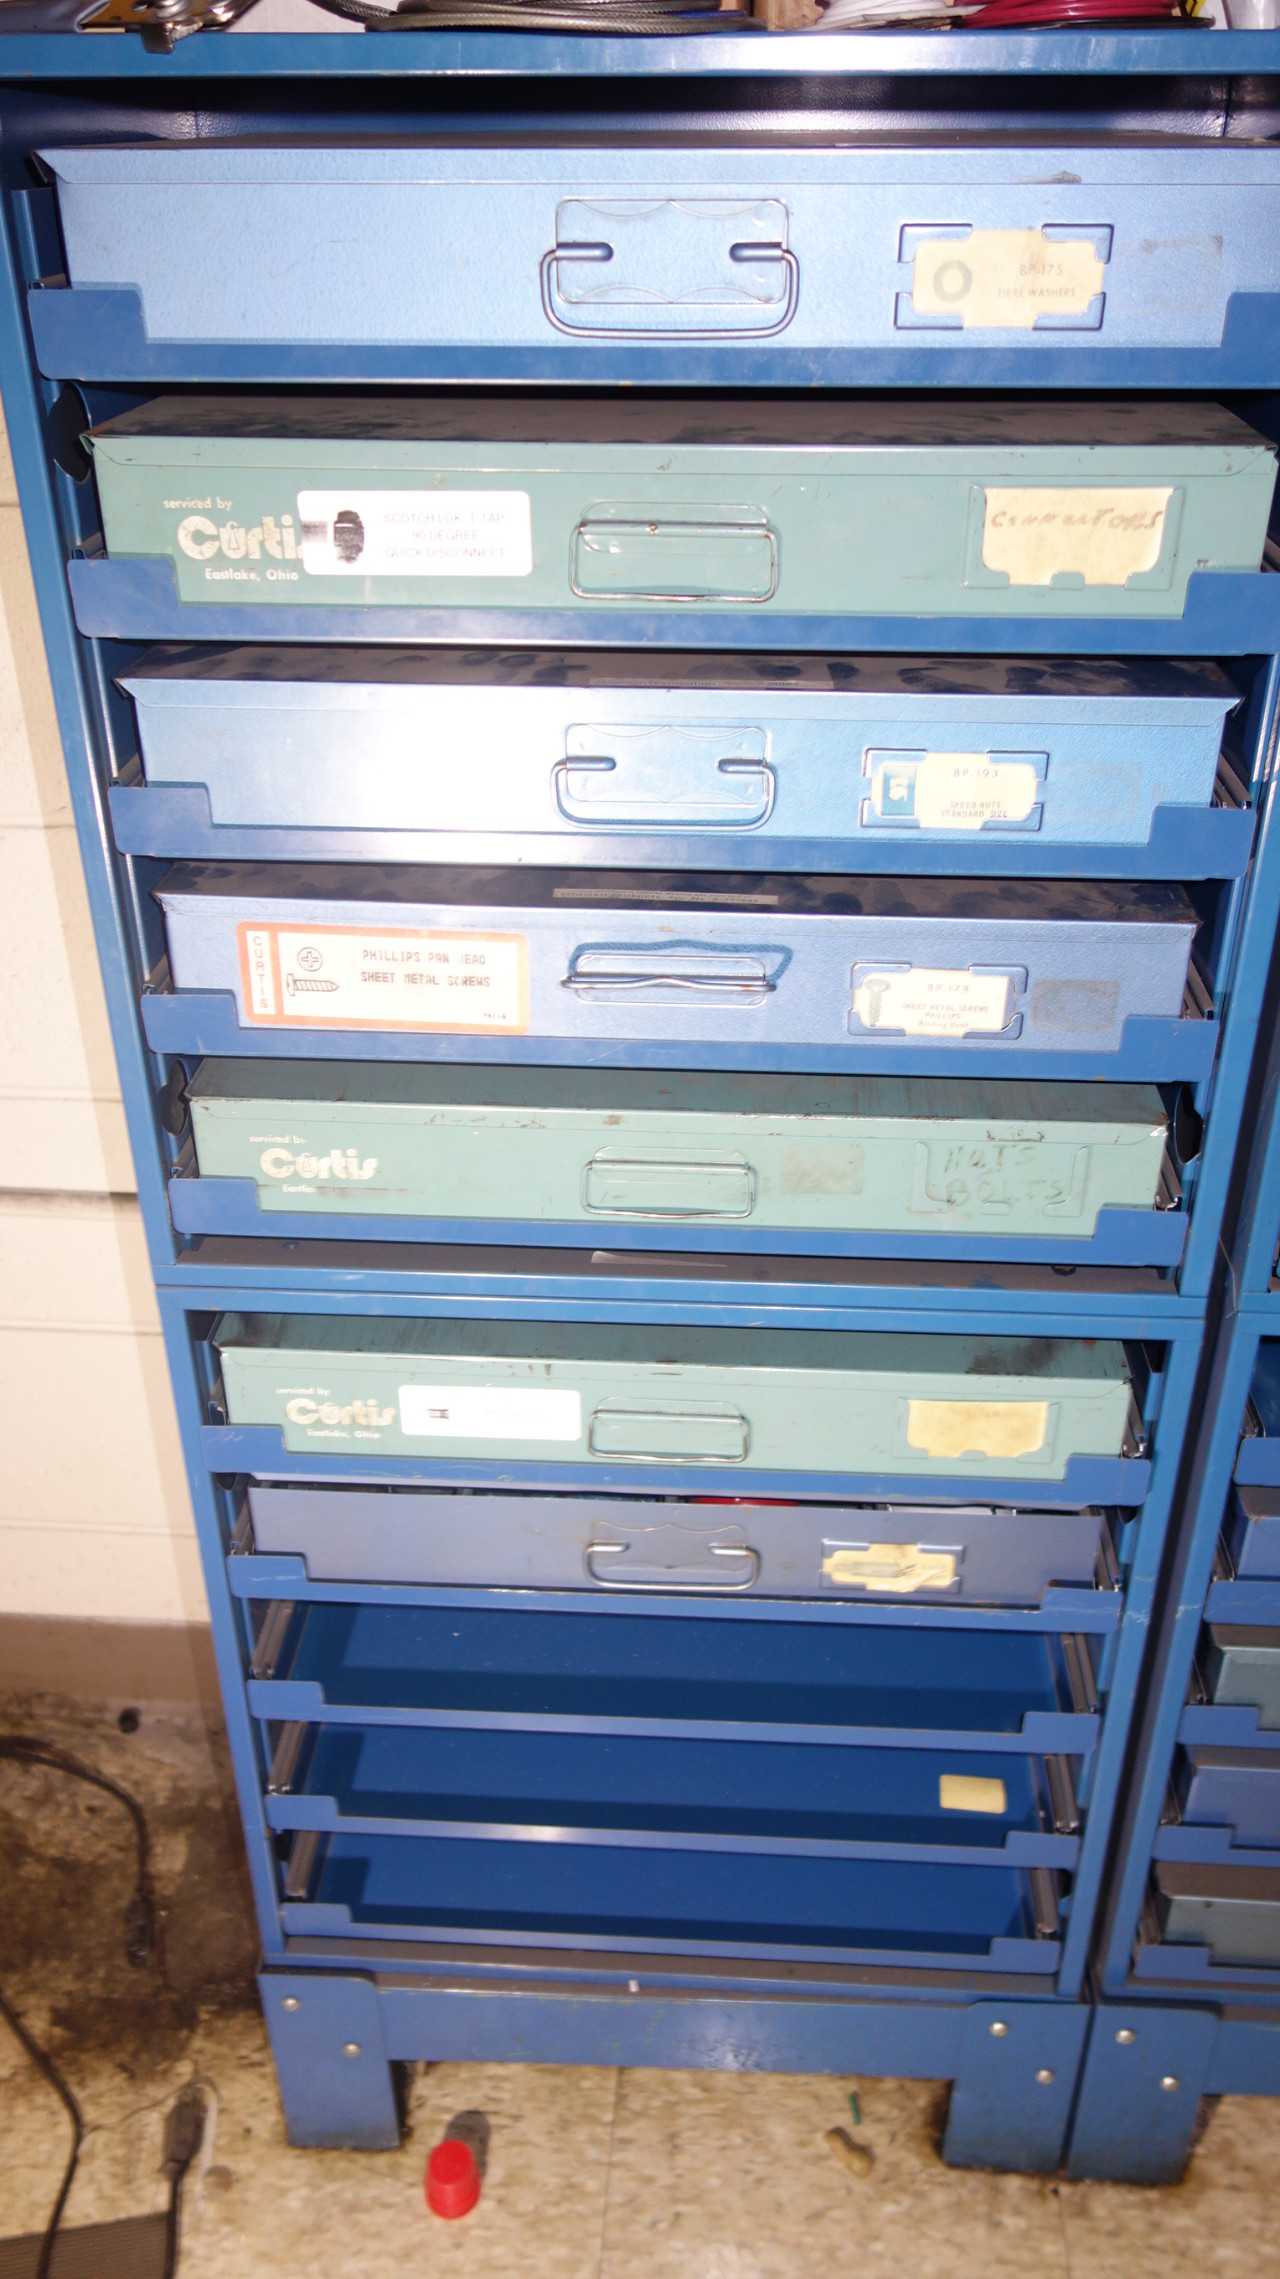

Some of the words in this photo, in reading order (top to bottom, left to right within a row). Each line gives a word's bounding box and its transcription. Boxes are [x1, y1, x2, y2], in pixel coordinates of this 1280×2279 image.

[162, 496, 212, 510] serviced
[215, 495, 233, 512] by
[177, 515, 303, 560] Curti
[204, 567, 261, 582] Eastlake,
[265, 568, 299, 582] Ohio
[361, 949, 421, 963] PHILLIPS
[427, 952, 450, 964] PAN
[457, 954, 487, 966] EAD
[360, 971, 396, 983] SHEET
[403, 973, 440, 986] METAL
[447, 975, 491, 987] SCREWS
[259, 1146, 380, 1181] Curtis
[286, 1398, 396, 1427] Curtis
